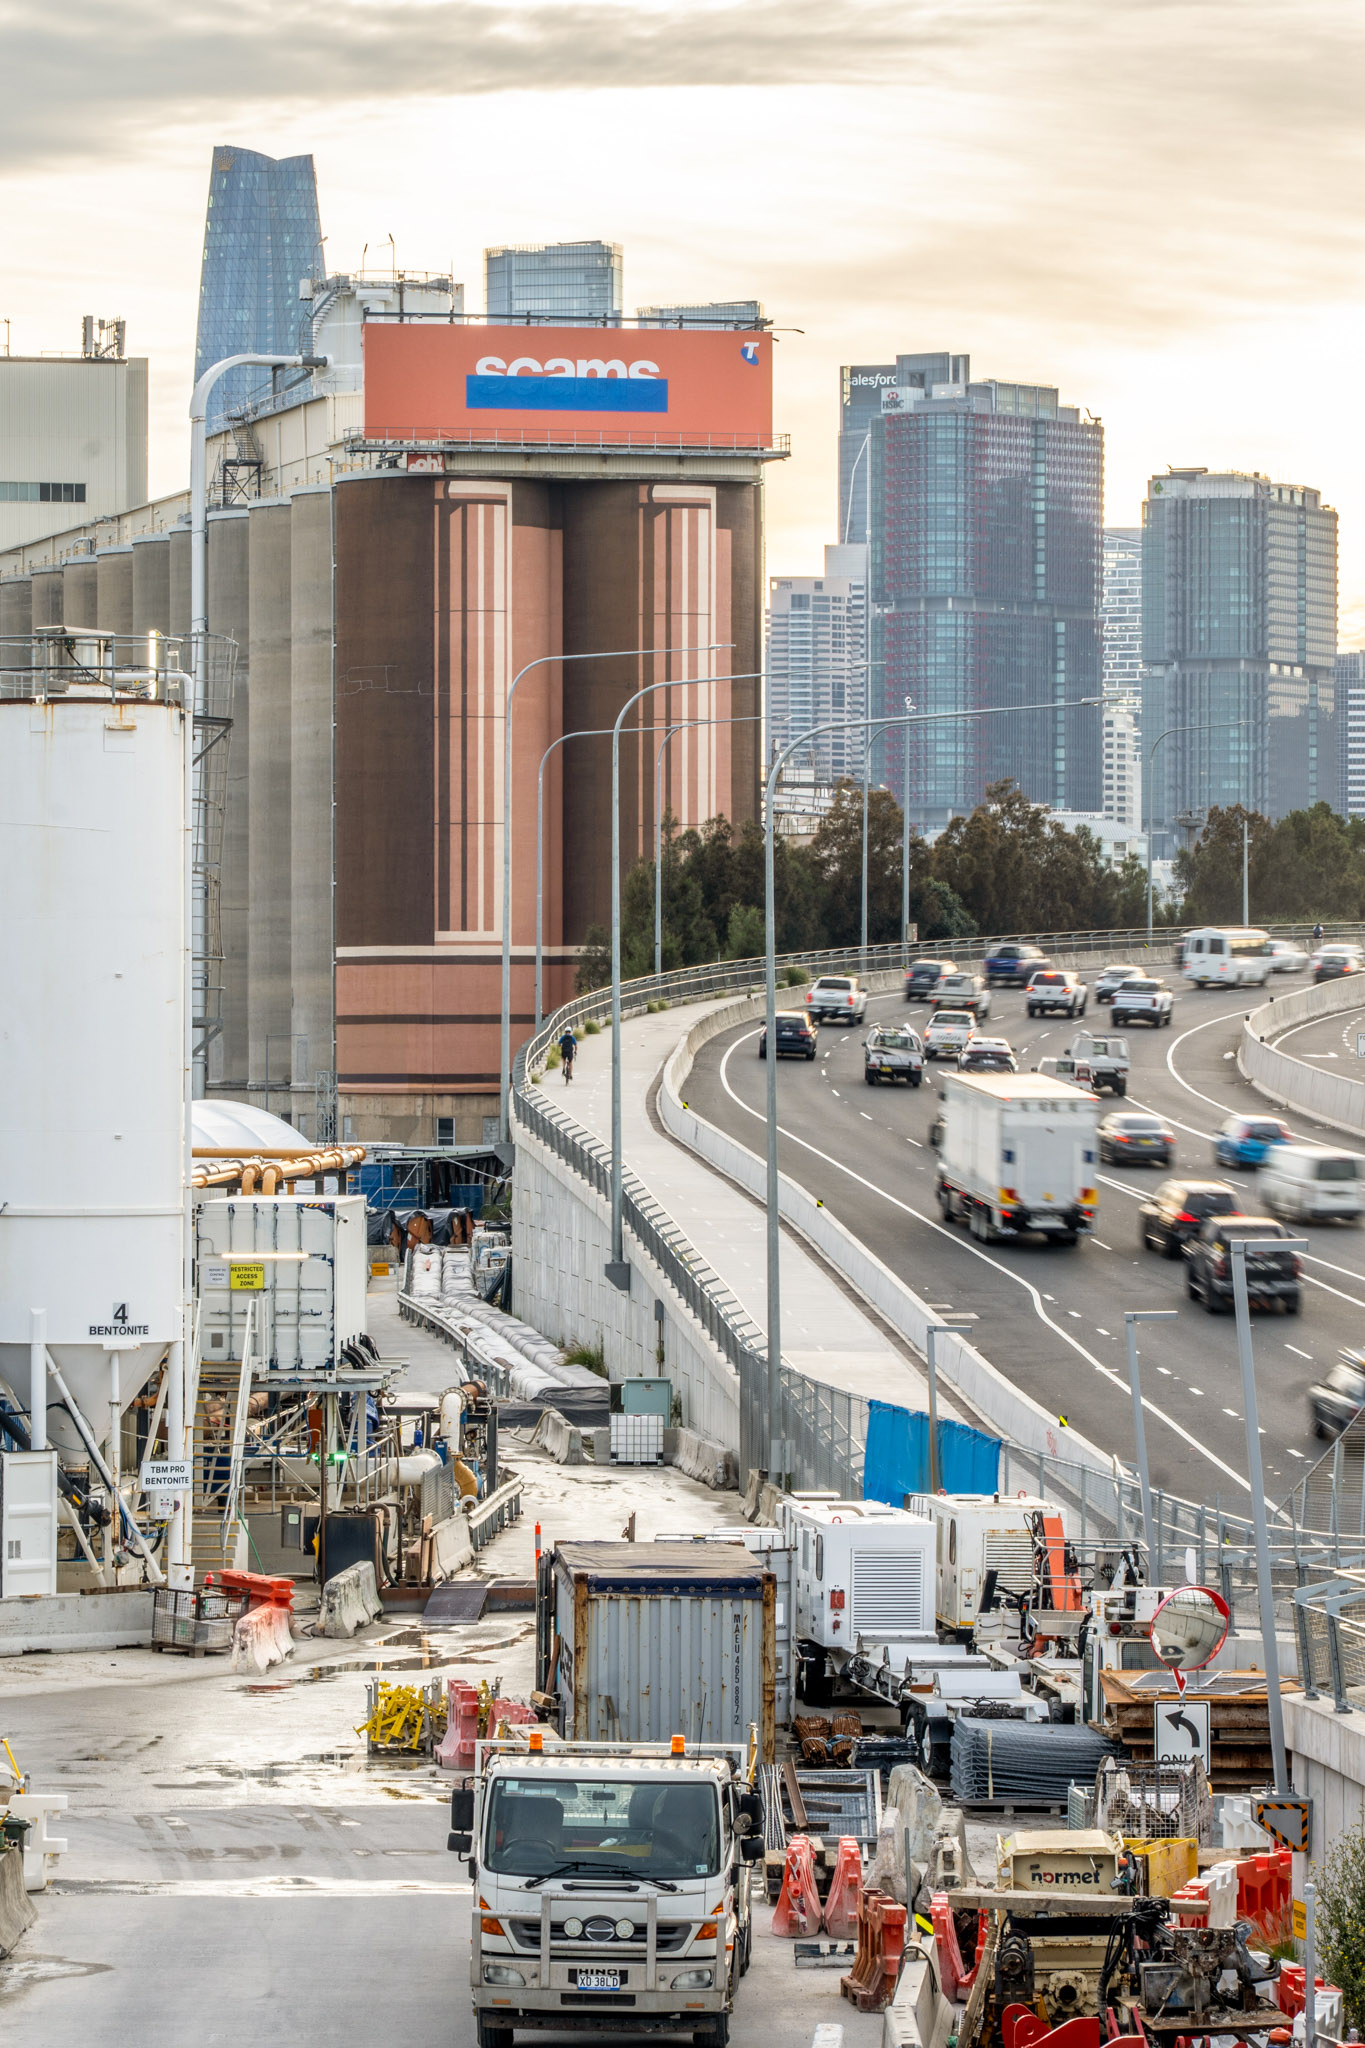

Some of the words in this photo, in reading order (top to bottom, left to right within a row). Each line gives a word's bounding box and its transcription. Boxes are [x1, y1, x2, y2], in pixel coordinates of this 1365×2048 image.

[882, 400, 904, 409] HSBC
[114, 1303, 128, 1324] 4
[89, 1326, 149, 1336] BENTONITE
[170, 1465, 185, 1473] PRO
[145, 1476, 190, 1485] BENTONITE
[1031, 1869, 1100, 1884] normet
[579, 1968, 618, 1976] HINO
